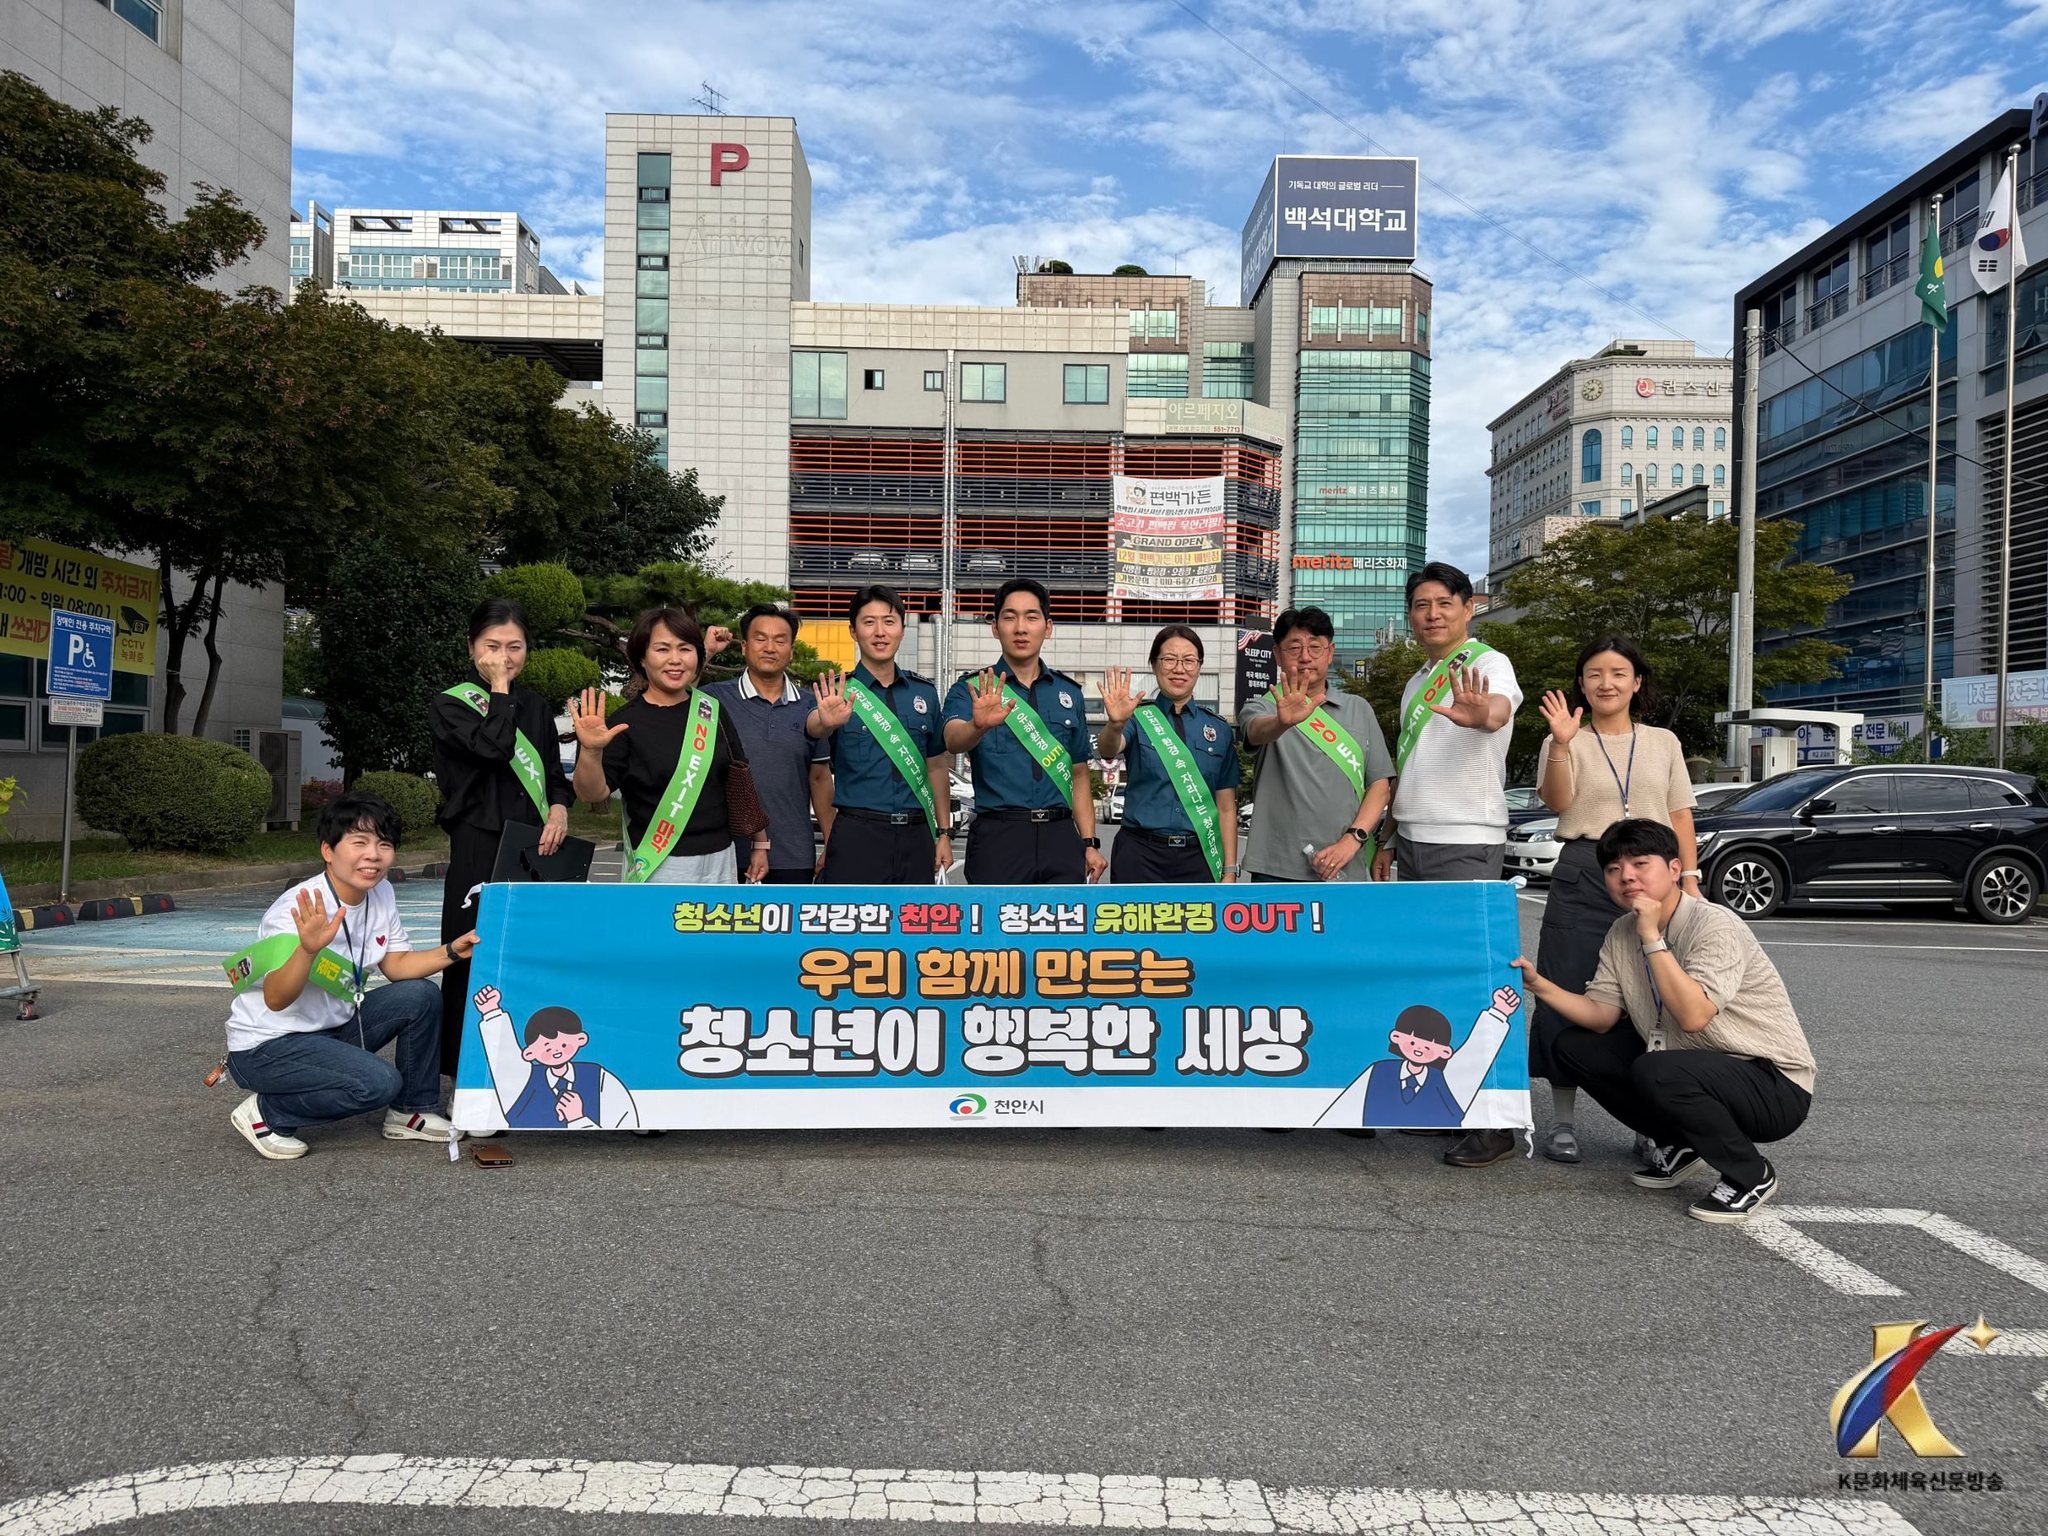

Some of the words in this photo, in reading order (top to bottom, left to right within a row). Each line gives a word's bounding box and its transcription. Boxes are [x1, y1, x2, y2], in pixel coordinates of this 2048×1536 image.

[710, 143, 750, 186] P
[1288, 180, 1312, 190] 기독교
[1313, 181, 1337, 190] 대학의
[1338, 181, 1361, 191] 글로벌
[1363, 182, 1379, 191] 리더
[1285, 207, 1407, 232] 백석대학교
[1663, 379, 1733, 396] 퀸스산
[1168, 403, 1239, 420] 아르페지오
[1150, 489, 1211, 506] 편백가든
[1133, 537, 1172, 547] GRAND
[1174, 537, 1204, 547] OPEN
[1293, 551, 1353, 571] meritz
[1353, 557, 1408, 570] 메리츠화재
[18, 549, 48, 578] 개방
[52, 558, 81, 587] 시간
[83, 566, 99, 591] 외
[101, 569, 152, 603] 주차금지
[0, 582, 26, 604] :00
[56, 615, 75, 628] 장애인
[76, 619, 88, 631] 전용
[89, 622, 111, 634] 주차구역
[68, 633, 84, 665] P
[121, 638, 145, 650] CCTV
[121, 650, 144, 663] 녹화중
[1245, 647, 1260, 657] SLEEP
[1261, 650, 1272, 659] CITY
[1423, 673, 1448, 703] NO
[693, 723, 708, 752] NO
[1016, 712, 1049, 751] 유해환경
[1041, 744, 1064, 768] OUT!
[1865, 722, 1885, 739] 전문
[1142, 709, 1165, 736] 안전한
[1161, 738, 1180, 756] 환경
[1180, 772, 1208, 815] 자라나는
[1308, 717, 1338, 744] NO
[1336, 742, 1364, 790] EXI
[516, 747, 546, 809] EXI
[670, 754, 701, 818] EXIT
[651, 819, 675, 854] 마약
[673, 902, 790, 935] 청소년이
[799, 903, 890, 934] 건강한
[899, 903, 961, 934] 천안
[998, 903, 1086, 934] 청소년
[1093, 902, 1215, 933] 유해환경
[1222, 902, 1303, 932] OUT
[798, 948, 905, 999] 우리
[915, 947, 1024, 999] 함께
[1034, 947, 1195, 998] 만드는
[678, 1004, 945, 1077] 청소년이
[962, 1004, 1158, 1076] 행복한
[1175, 1003, 1313, 1076] 세상
[994, 1100, 1044, 1115] 천안시
